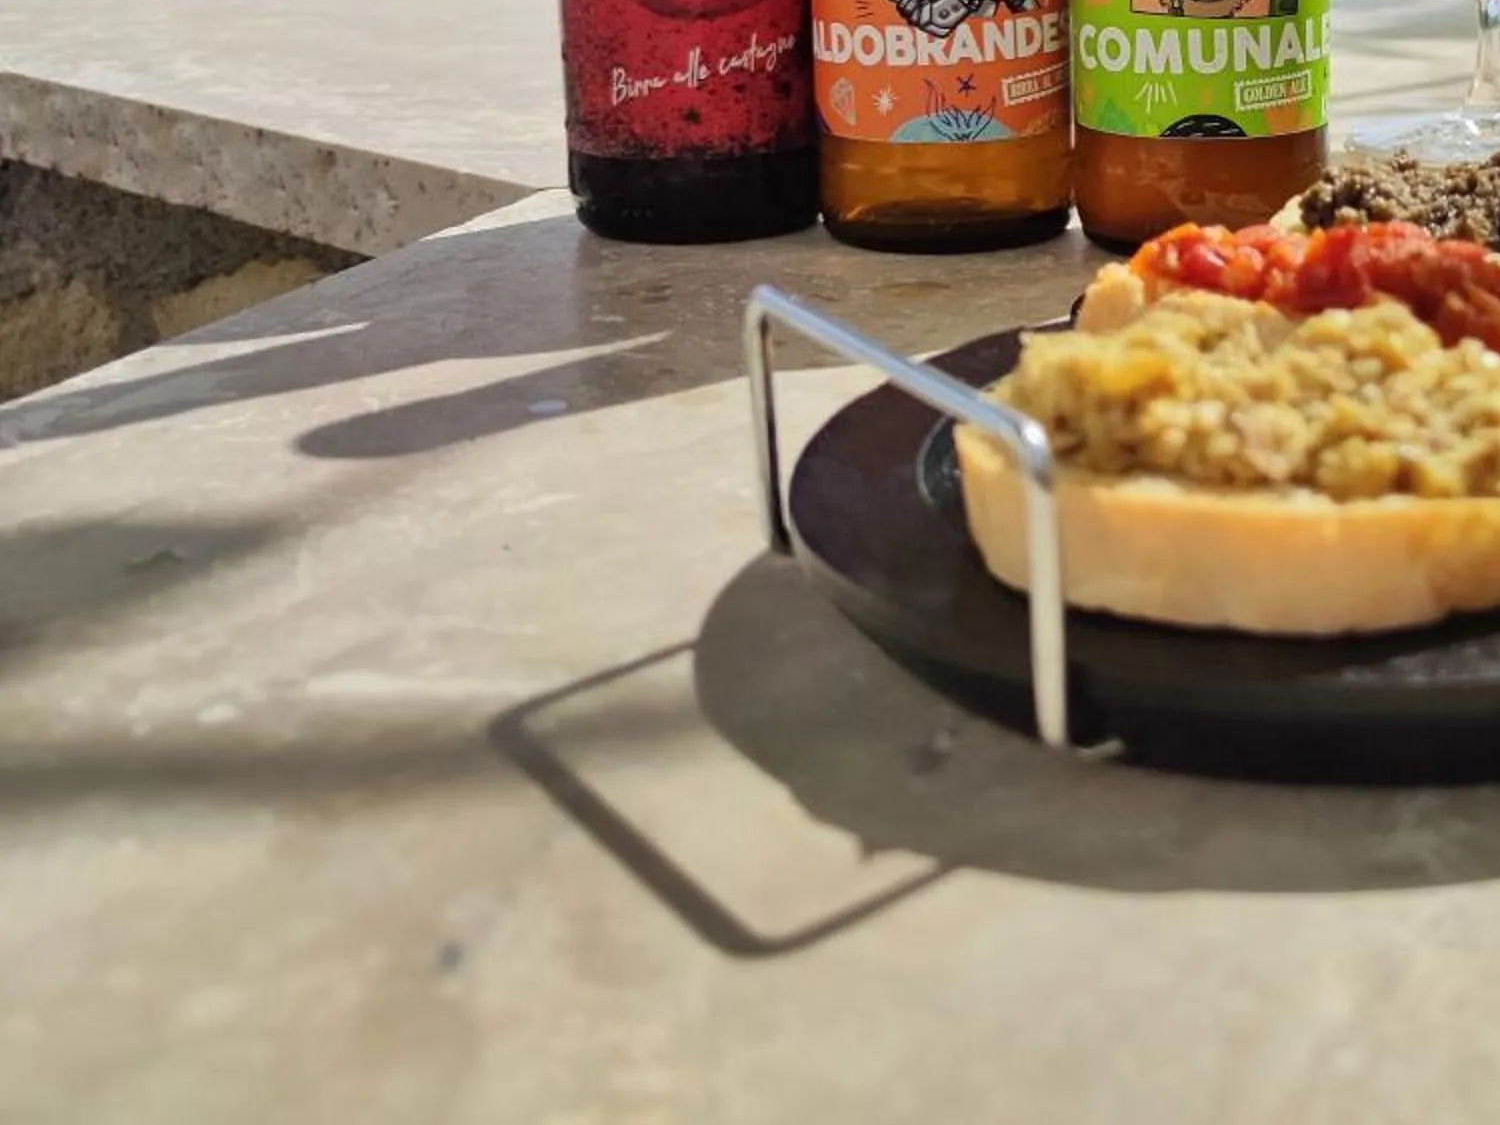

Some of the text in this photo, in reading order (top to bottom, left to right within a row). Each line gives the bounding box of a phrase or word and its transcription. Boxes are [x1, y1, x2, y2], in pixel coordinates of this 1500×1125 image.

[611, 66, 667, 106] Birra
[673, 46, 710, 88] alle
[1243, 77, 1307, 104] GOLDEN ALE
